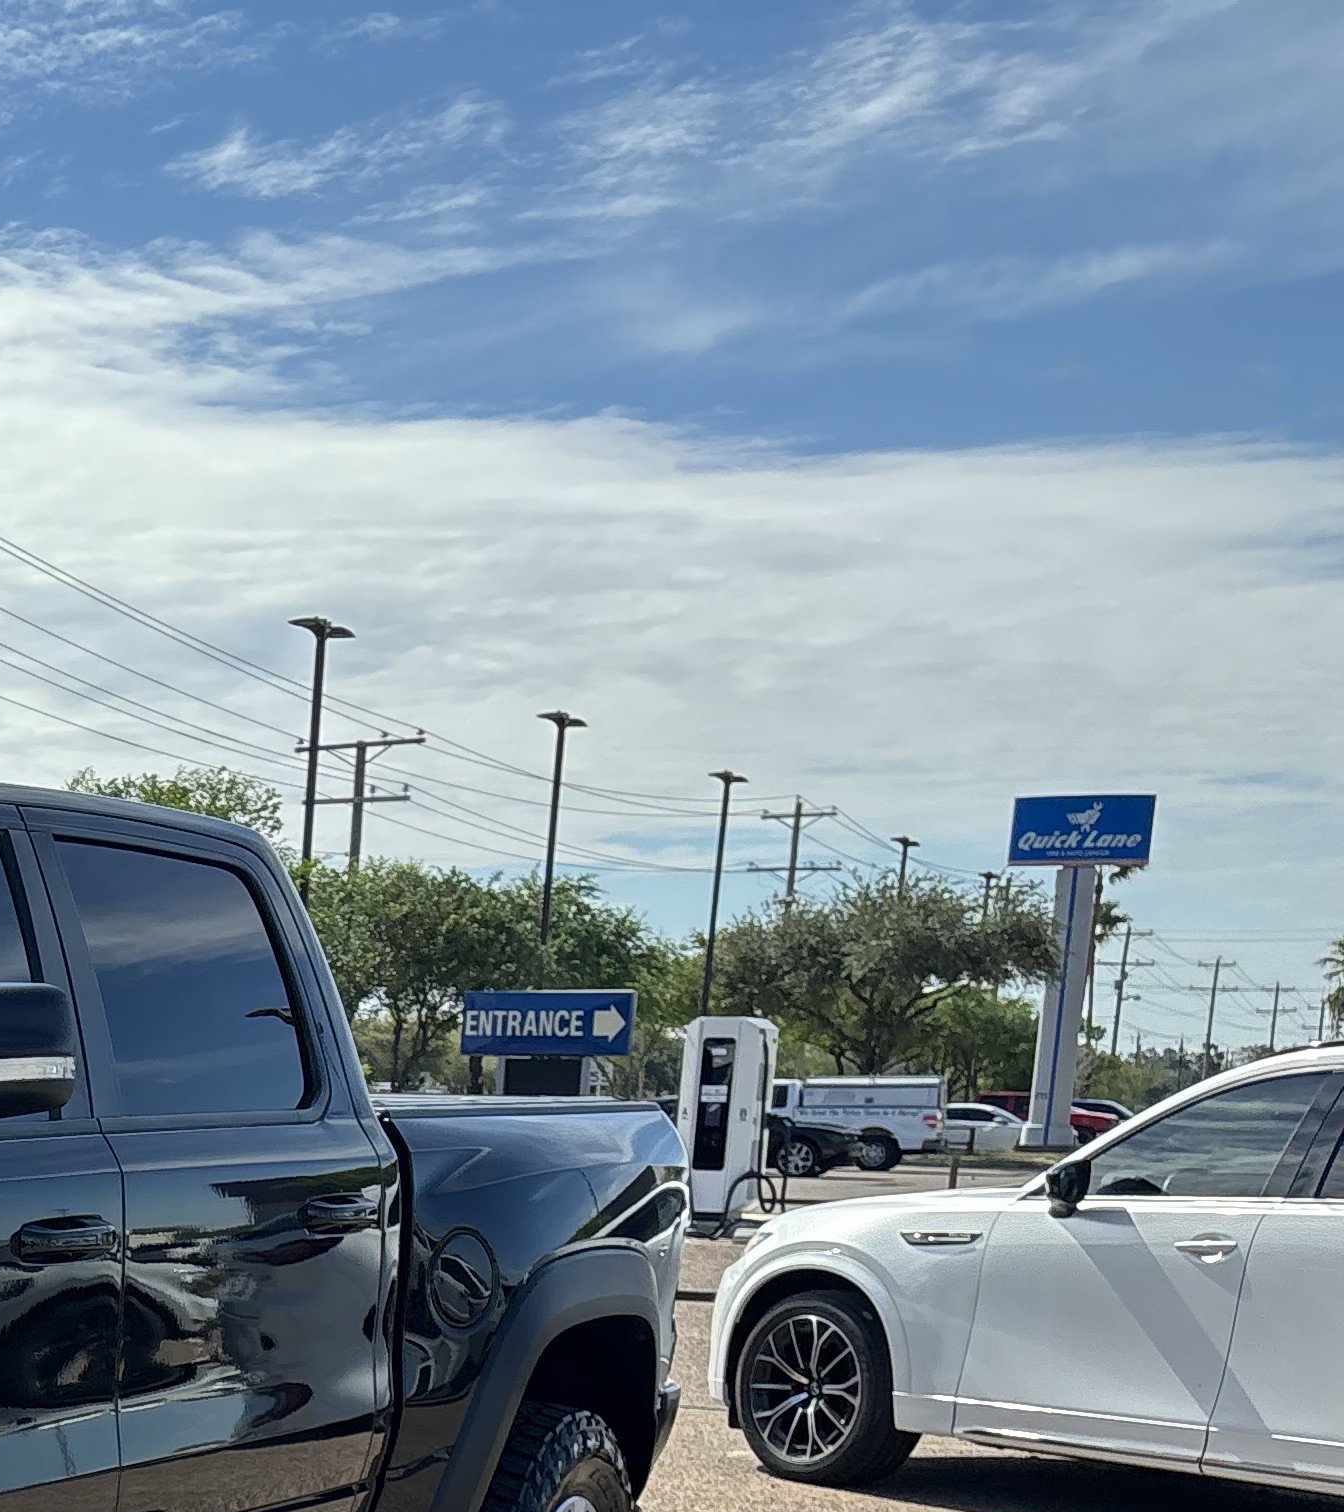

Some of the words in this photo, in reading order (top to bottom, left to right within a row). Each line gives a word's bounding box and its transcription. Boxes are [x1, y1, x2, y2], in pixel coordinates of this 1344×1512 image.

[1017, 830, 1082, 851] Quick
[1082, 829, 1142, 849] Lane
[464, 1009, 585, 1037] ENTRANCE
